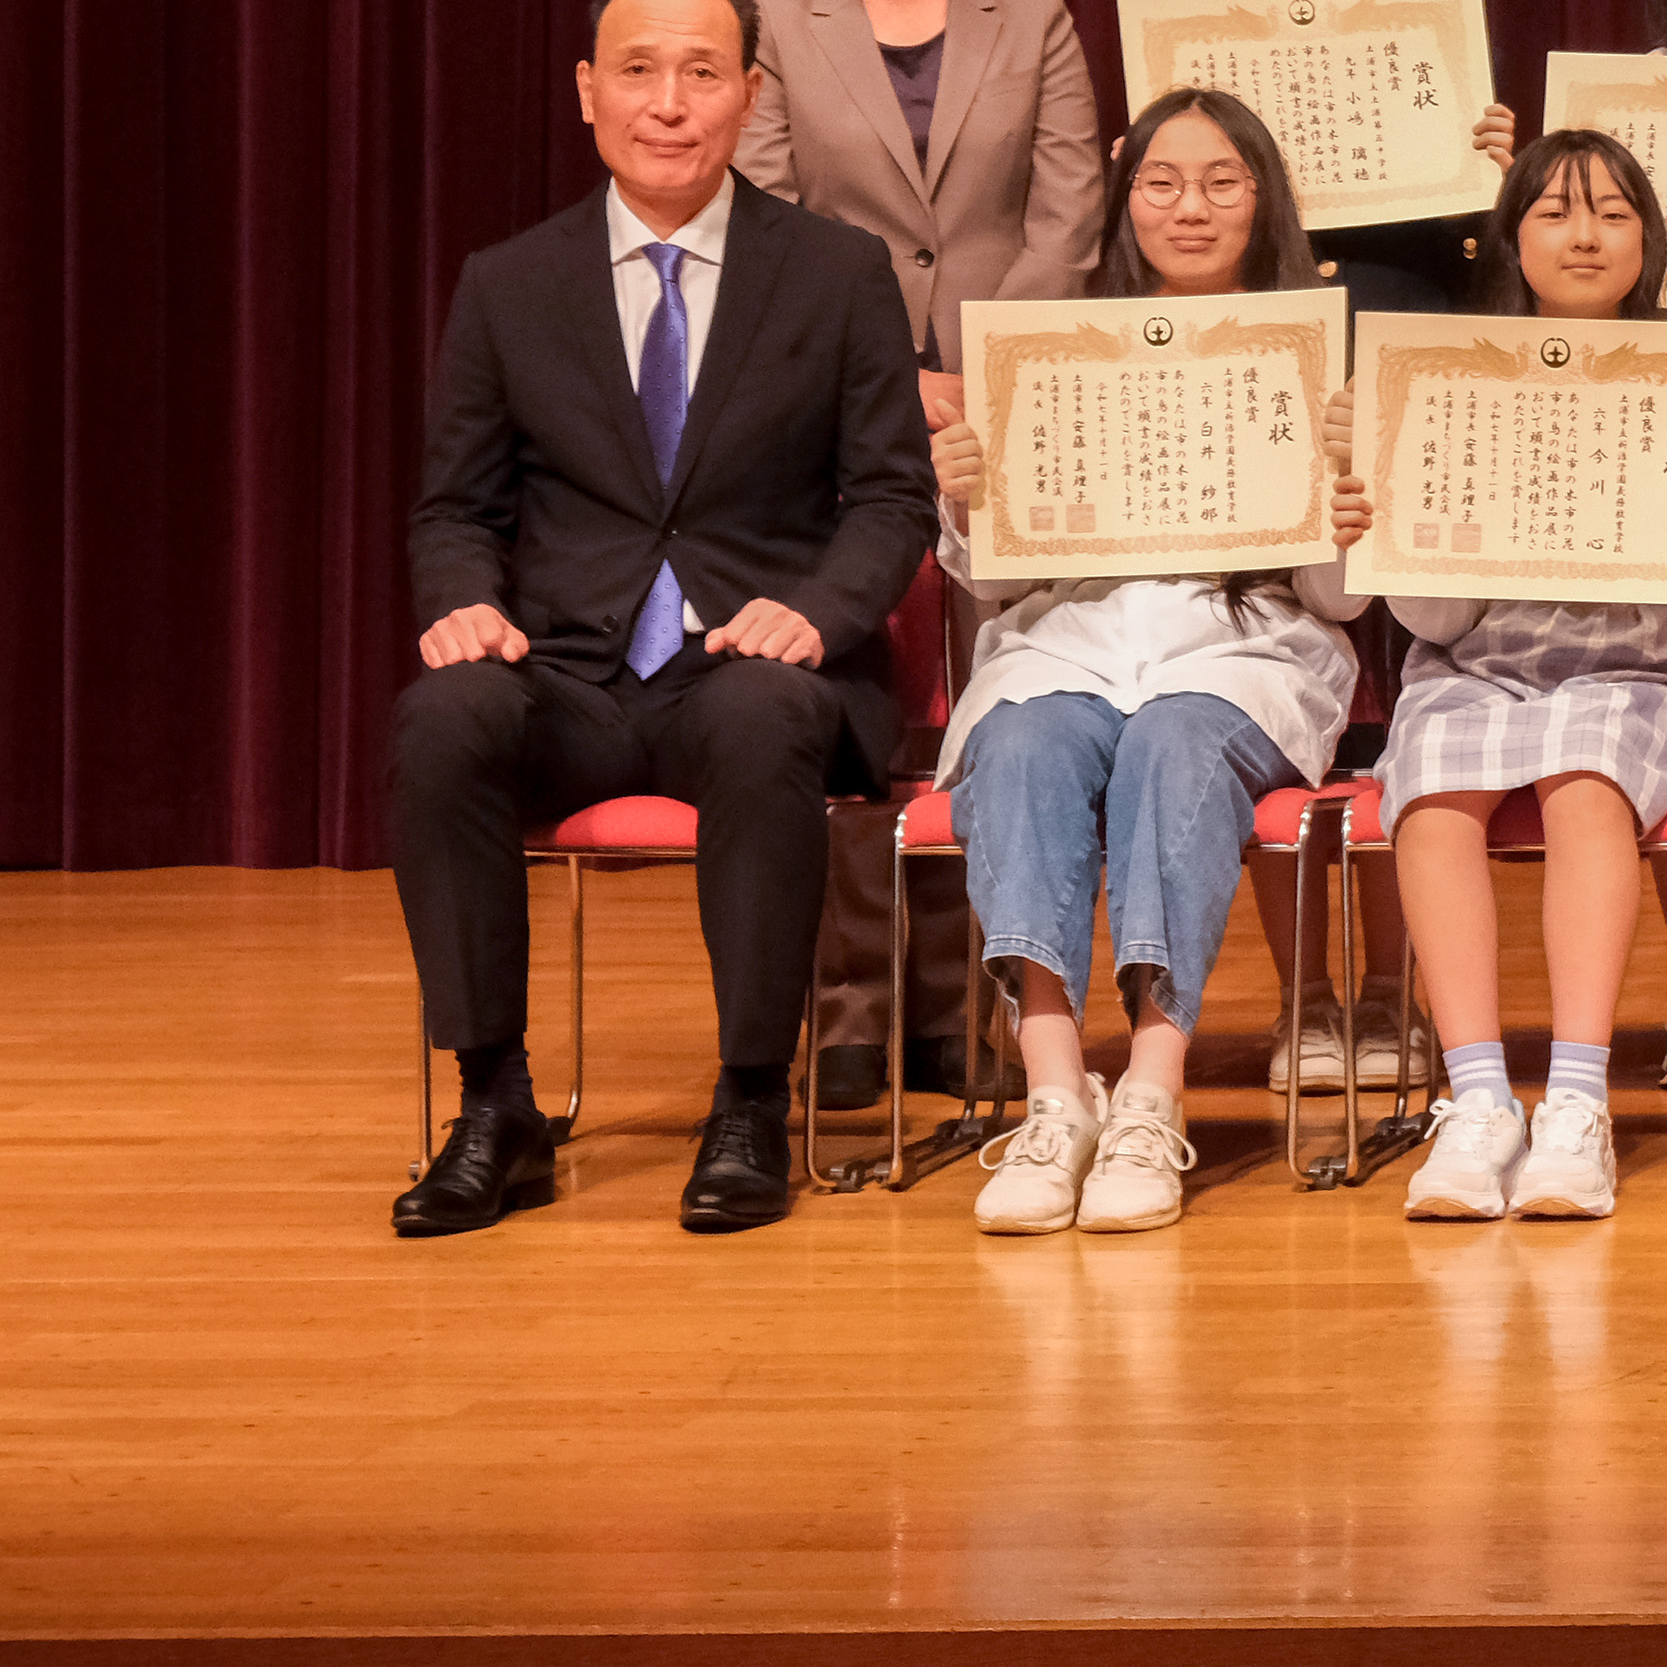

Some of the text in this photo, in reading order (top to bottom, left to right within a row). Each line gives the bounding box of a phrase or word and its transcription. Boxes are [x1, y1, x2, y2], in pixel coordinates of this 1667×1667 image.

[1383, 41, 1402, 91] 優良賞
[1412, 61, 1439, 111] 賞状
[1200, 382, 1213, 409] 六年
[1242, 367, 1260, 423] 優良賞
[1268, 390, 1295, 445] 賞状
[1200, 421, 1216, 460] 白井
[1639, 396, 1656, 453] 優良賞
[1586, 407, 1609, 550] 六年 今川 心
